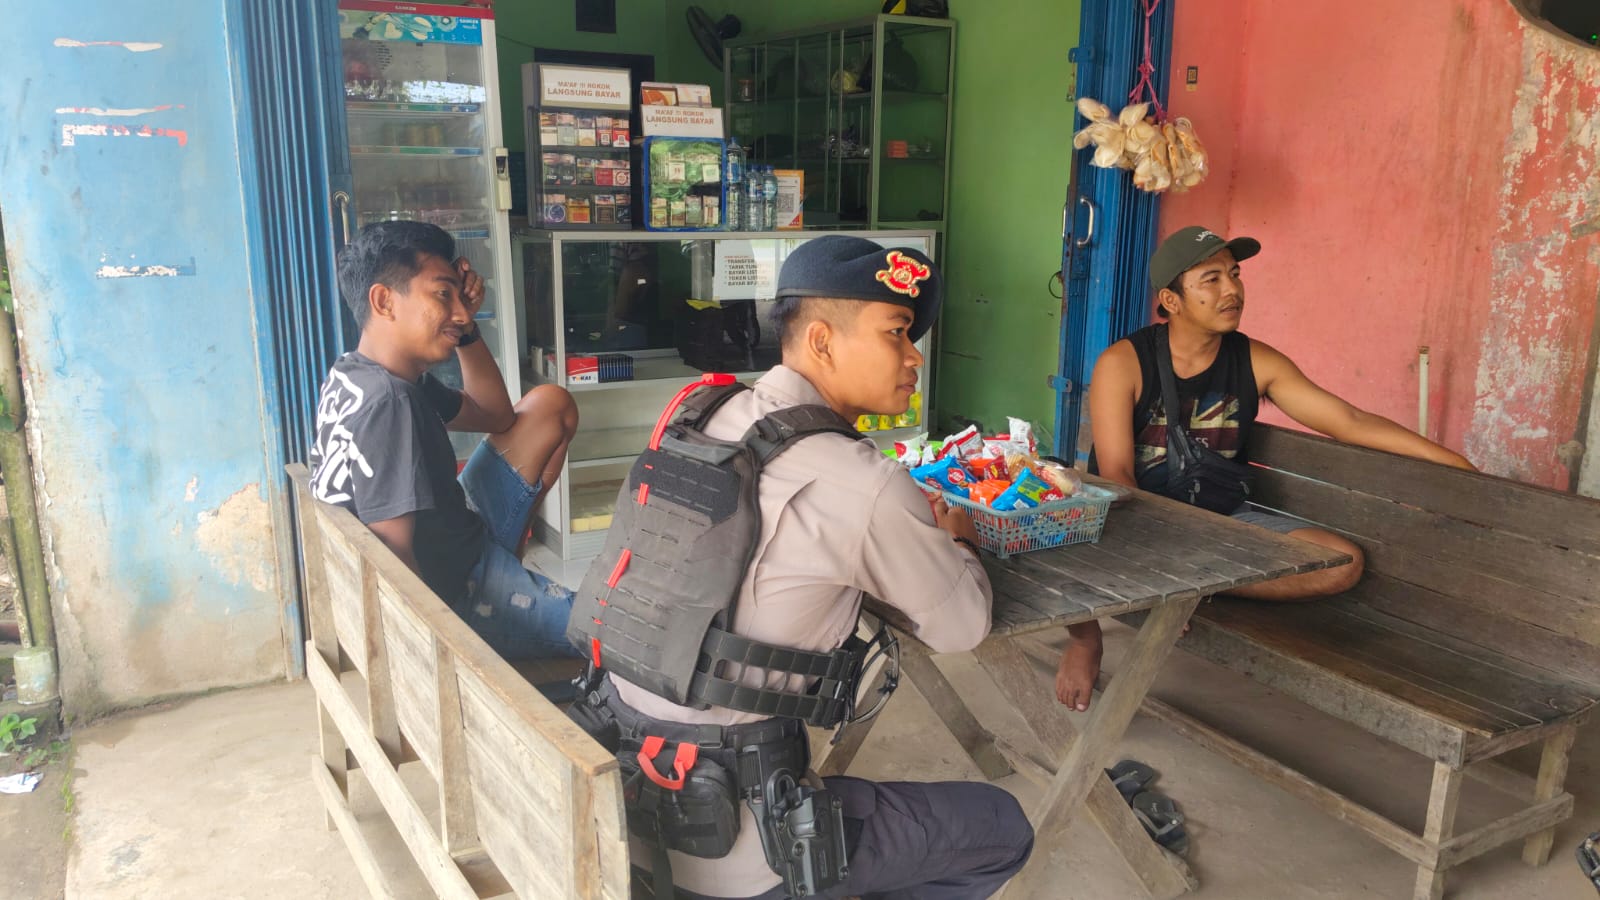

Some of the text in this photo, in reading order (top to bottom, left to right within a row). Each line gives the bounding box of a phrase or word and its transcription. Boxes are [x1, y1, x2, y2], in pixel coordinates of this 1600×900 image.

[547, 88, 621, 99] LANGSUNG BAYAR
[646, 115, 715, 125] LANGSUNG BAYAR
